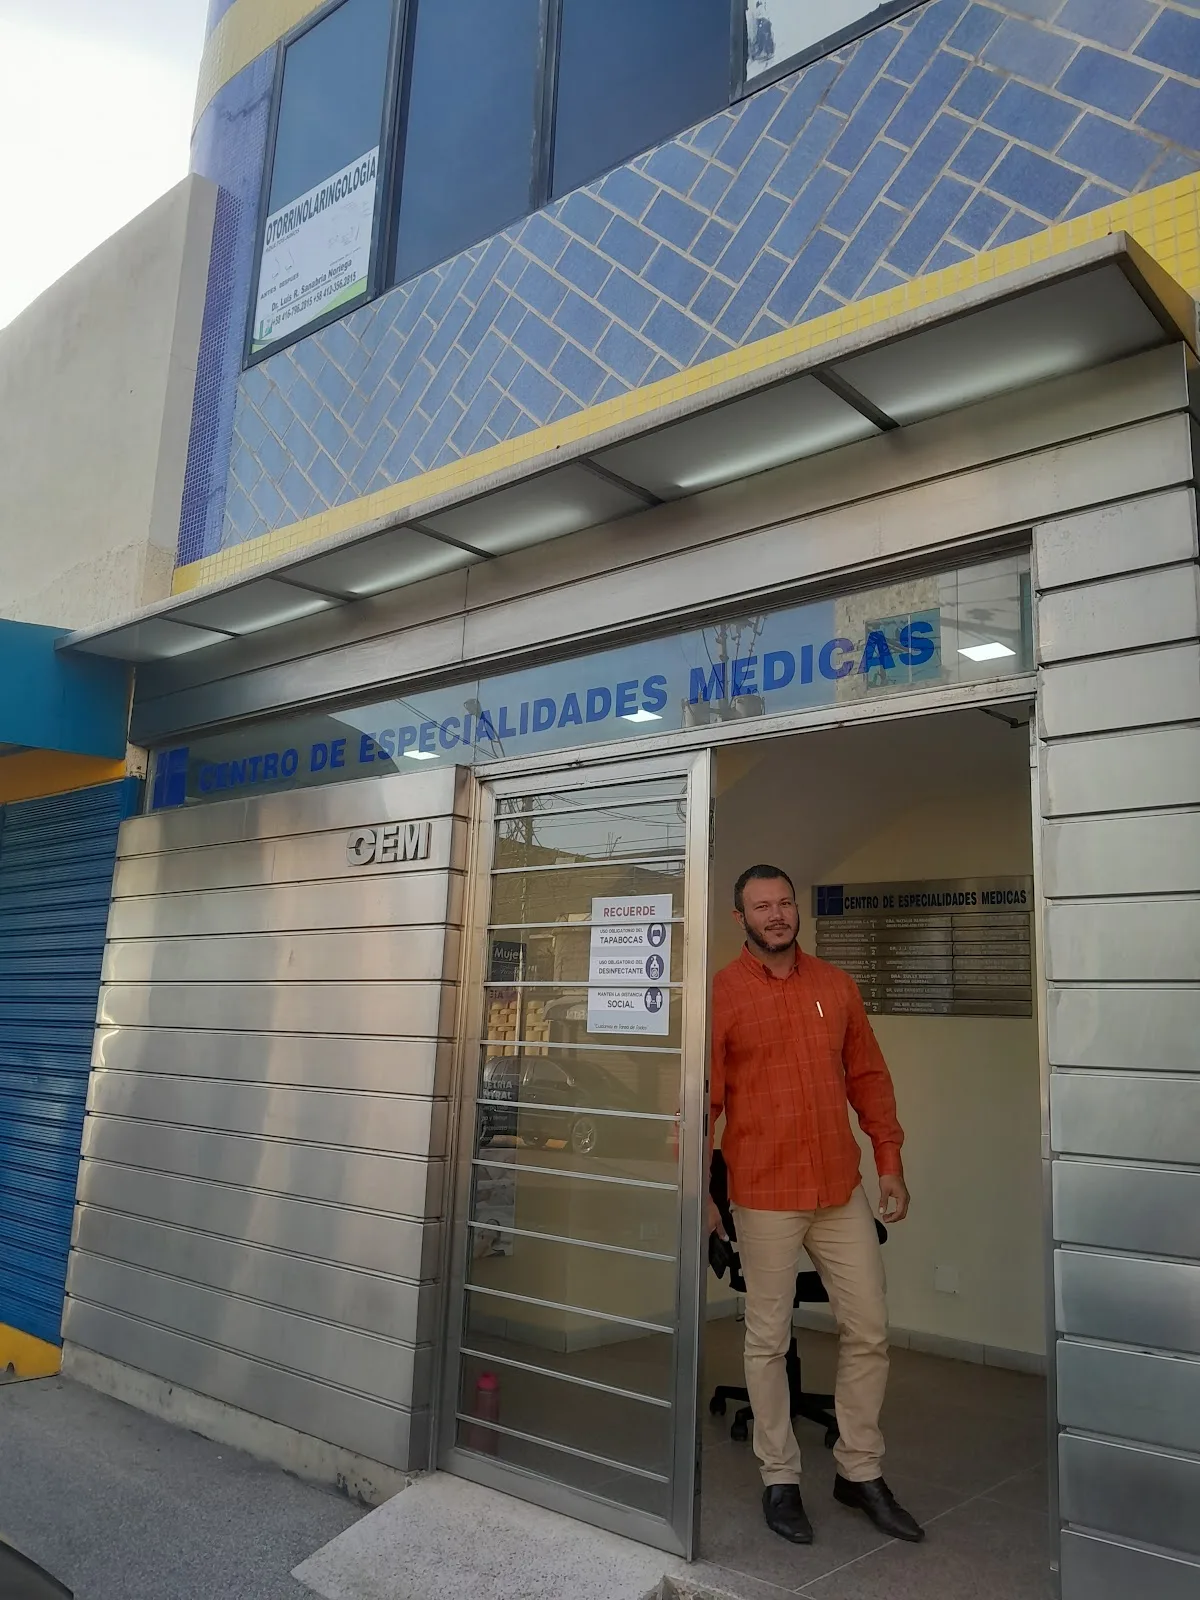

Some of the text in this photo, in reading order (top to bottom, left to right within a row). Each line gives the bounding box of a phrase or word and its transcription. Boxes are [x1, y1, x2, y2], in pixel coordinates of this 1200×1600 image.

[266, 155, 376, 246] OTORRINOLARINGOLOGÍA
[260, 285, 277, 299] ANTES
[271, 259, 352, 312] Dr. Luis R. Sanabria Noriega
[200, 621, 935, 792] CENTRO DE ESPECIALIDADES MEDICAS
[844, 889, 1027, 909] CENTRO DE ESPECIALIDADES MEDICAS
[603, 905, 656, 918] RECUERDE
[600, 935, 643, 944] TAPABOCAS
[598, 967, 643, 975] DESINFECTANTE
[607, 999, 634, 1009] SOCIAL
